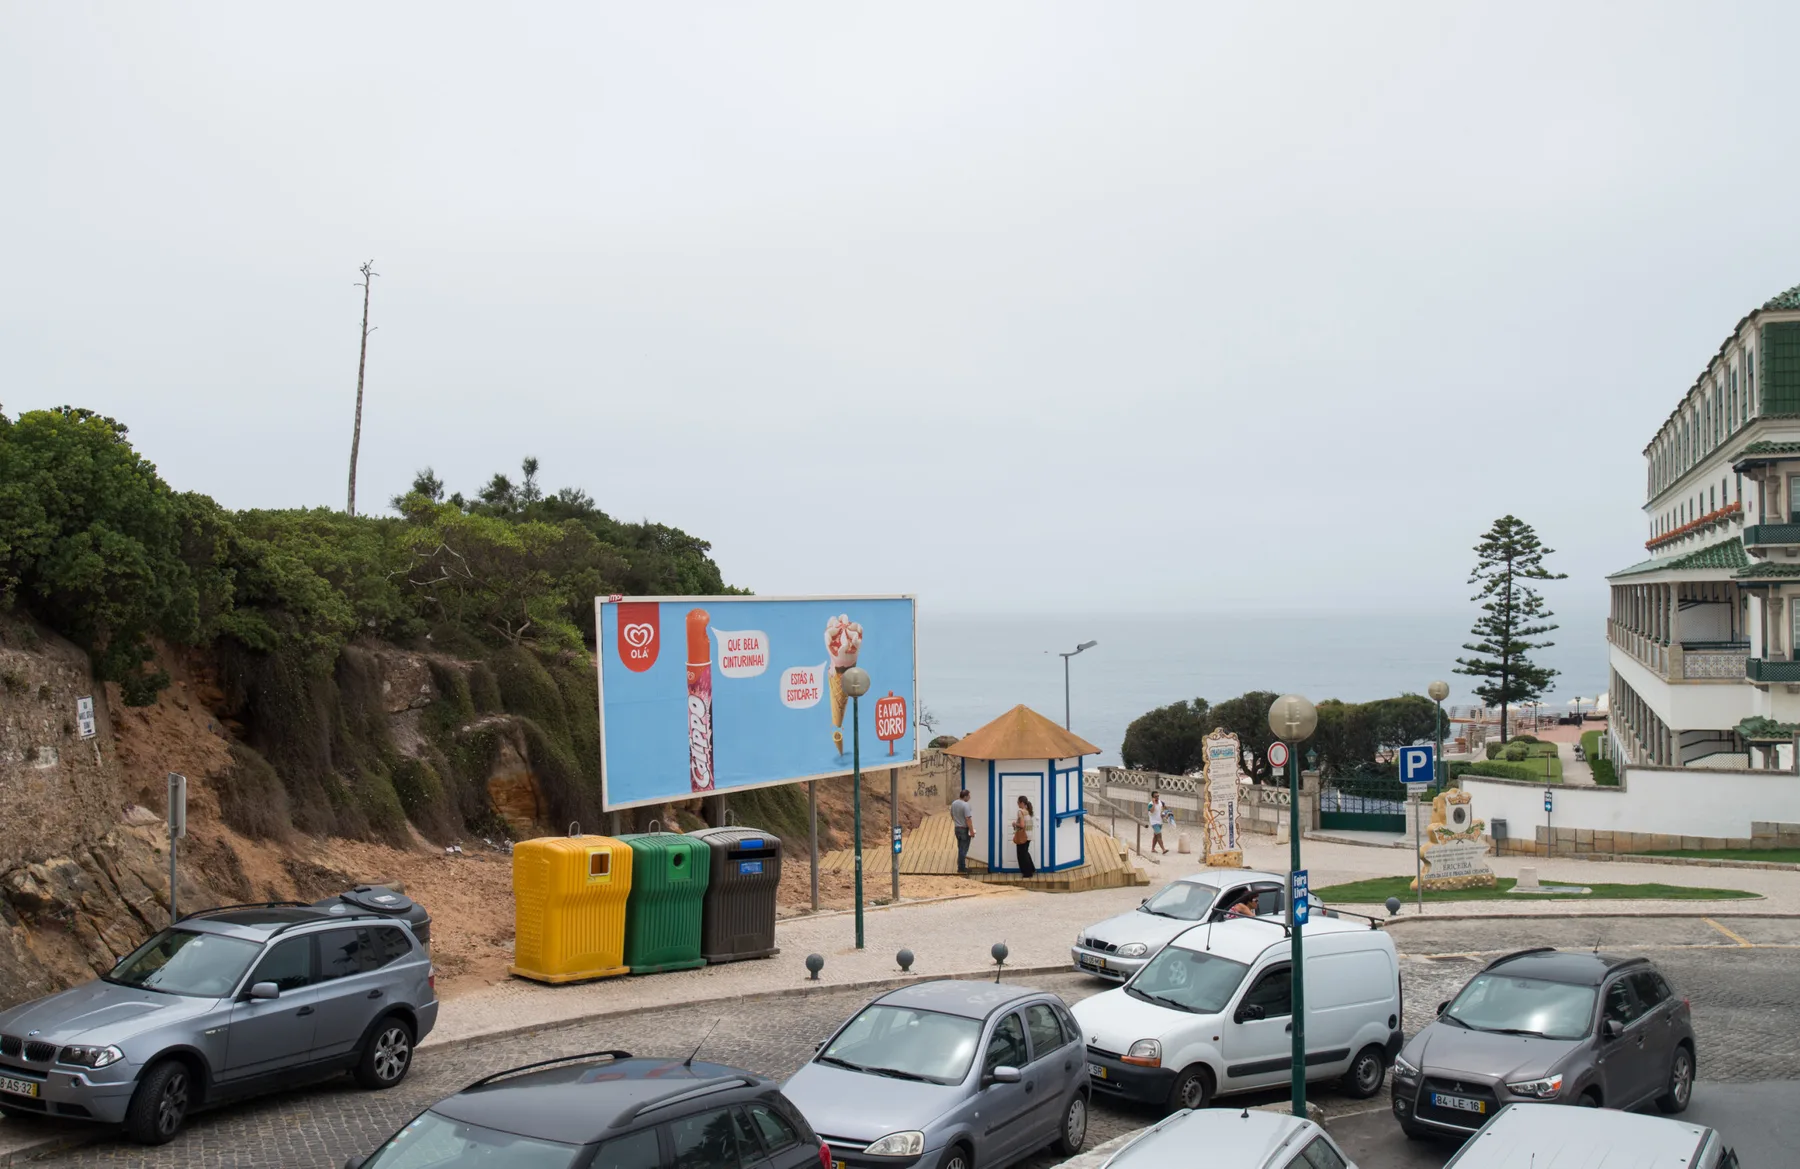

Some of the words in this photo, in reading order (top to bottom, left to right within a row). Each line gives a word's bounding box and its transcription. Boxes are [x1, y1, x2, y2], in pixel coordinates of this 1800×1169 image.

[728, 638, 741, 652] QUE
[743, 637, 759, 650] BELA
[631, 646, 648, 659] OLÁ
[722, 653, 765, 669] CINTURINHA!
[790, 670, 808, 685] ESTÁS
[809, 672, 815, 684] A
[787, 687, 818, 702] ESTICAR-TE
[878, 704, 883, 718] E
[883, 703, 889, 718] A
[888, 702, 904, 717] VIDA
[878, 717, 904, 737] SORRI
[1407, 750, 1427, 779] P
[1442, 861, 1472, 871] ERICEIRA
[1293, 875, 1307, 887] Feira
[1294, 887, 1307, 899] Livro
